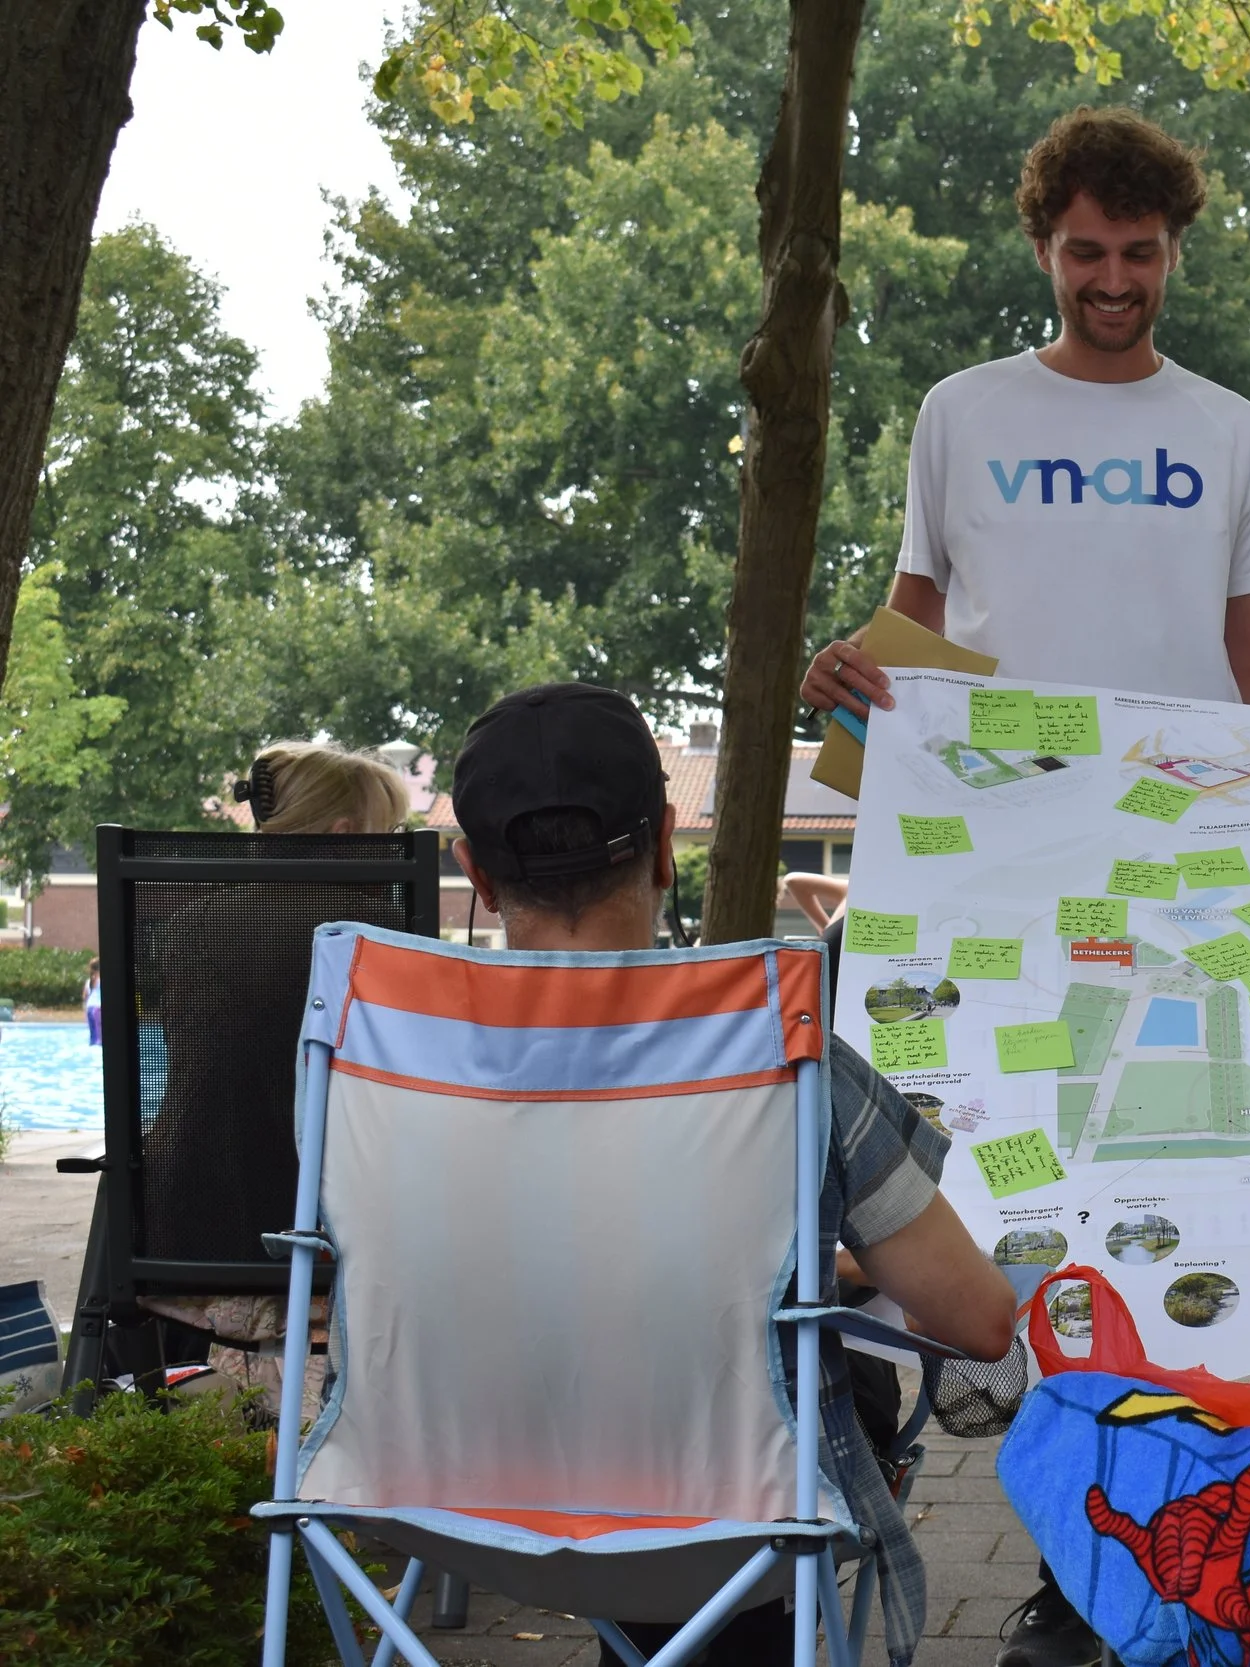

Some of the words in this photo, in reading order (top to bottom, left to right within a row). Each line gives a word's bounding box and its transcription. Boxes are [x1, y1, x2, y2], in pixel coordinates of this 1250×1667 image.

[945, 678, 985, 688] PLEJADENPLEIN
[927, 1079, 962, 1087] grasveld
[1113, 1196, 1170, 1204] Oppervlakte-
[999, 1206, 1064, 1217] Waterbergende
[1002, 1213, 1053, 1225] groenstrook
[1077, 1210, 1090, 1225] ?
[1173, 1260, 1220, 1269] Beplanting
